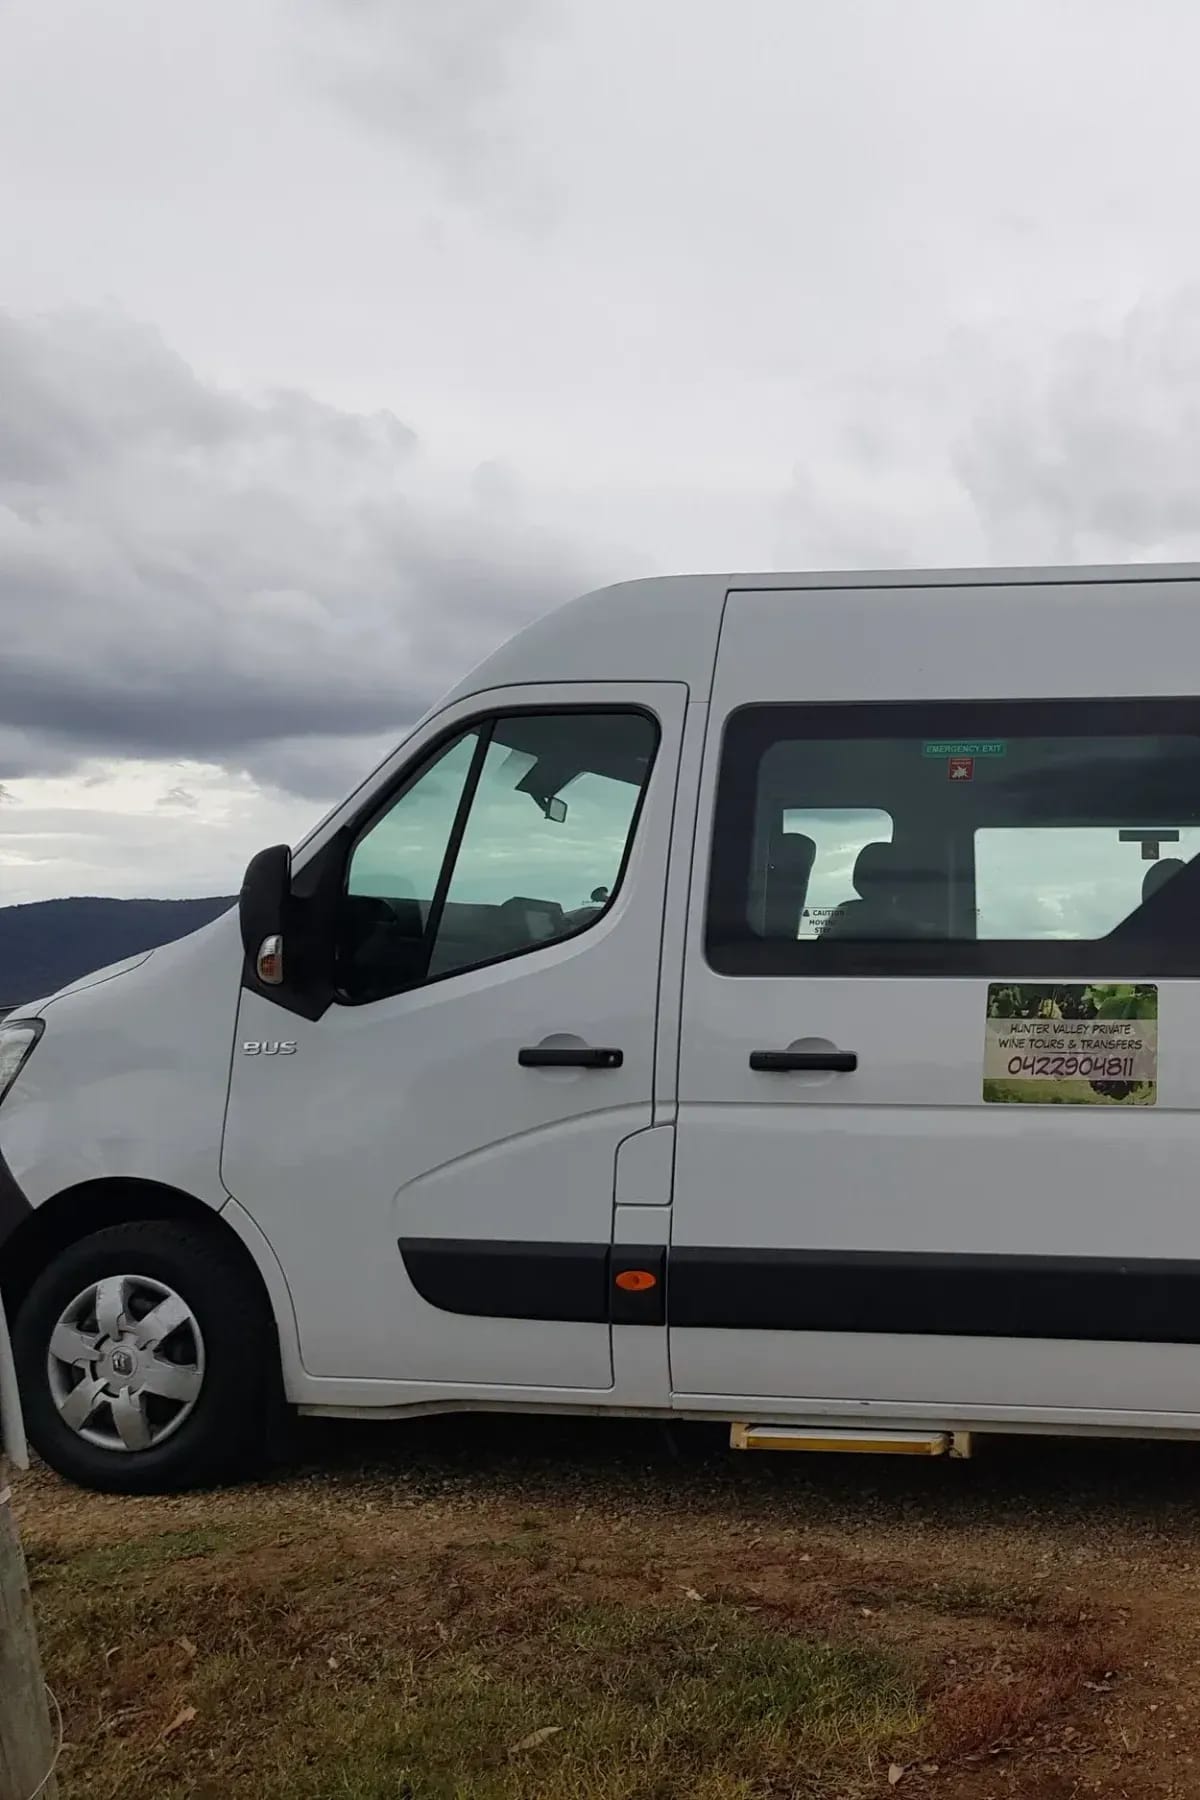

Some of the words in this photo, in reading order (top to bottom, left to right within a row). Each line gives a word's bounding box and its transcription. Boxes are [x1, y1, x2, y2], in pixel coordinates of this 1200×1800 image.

[926, 744, 980, 753] EMERGENCY
[982, 743, 1002, 753] EXIT
[812, 909, 845, 917] CAUTION
[1009, 1023, 1050, 1035] HUNTER
[1052, 1023, 1090, 1035] VALLEY
[1091, 1023, 1132, 1035] PRIVATE
[242, 1040, 298, 1056] BUS
[998, 1038, 1026, 1049] WINE
[1028, 1038, 1065, 1050] TOURS
[1067, 1039, 1077, 1050] &
[1080, 1039, 1143, 1050] TRANSFERS
[1007, 1055, 1135, 1077] 0422904811
